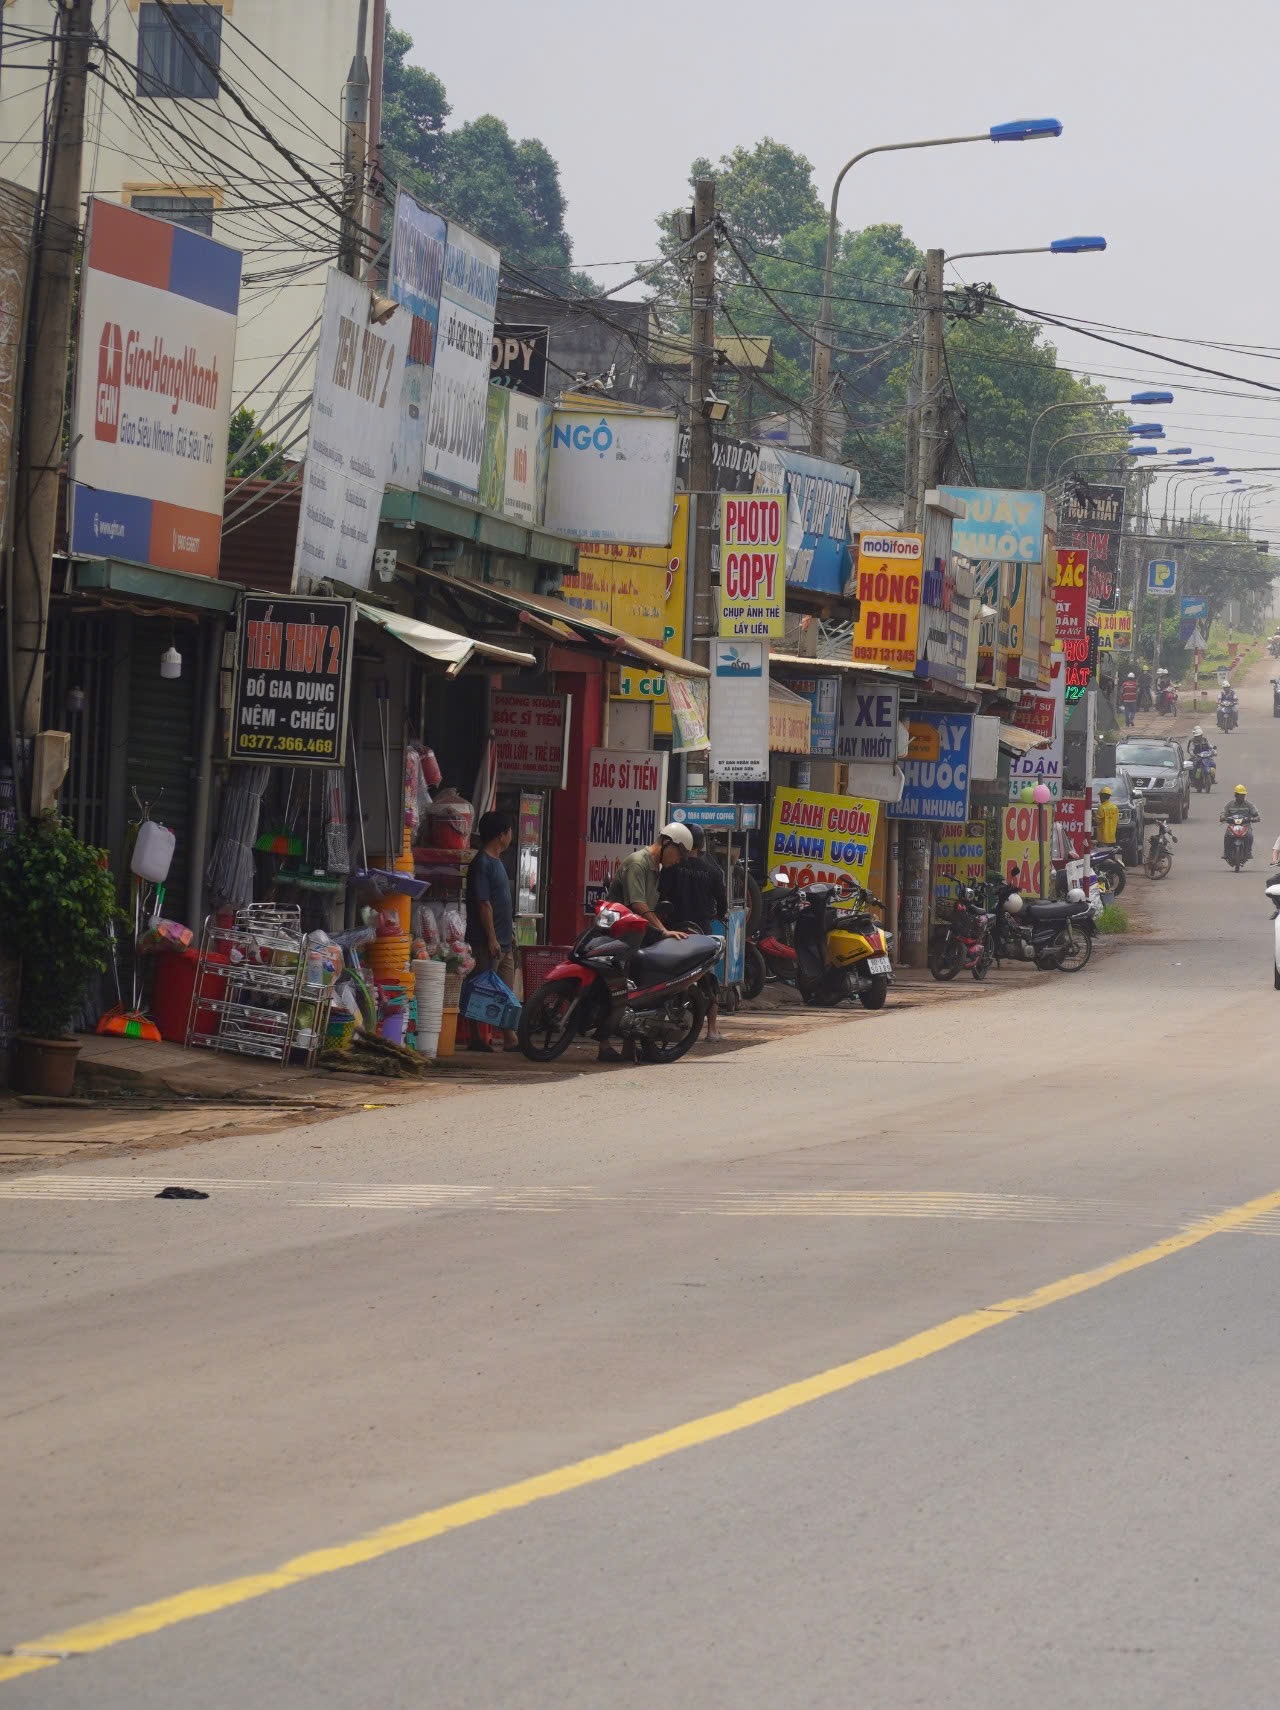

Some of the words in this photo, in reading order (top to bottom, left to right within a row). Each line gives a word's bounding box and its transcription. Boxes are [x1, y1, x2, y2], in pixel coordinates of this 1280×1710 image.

[492, 336, 537, 371] OPY
[124, 329, 219, 415] GiaoHangNhanh
[554, 417, 613, 458] NGỘ
[726, 500, 781, 545] PHOTO
[863, 539, 920, 555] mobifone
[953, 523, 1035, 559] HUỐC
[726, 552, 777, 599] COPY
[860, 563, 920, 606] HỒNG
[723, 606, 745, 620] CHỤP
[866, 611, 906, 642] PHI
[247, 604, 283, 671] TIẾN
[327, 626, 341, 674] 2
[269, 679, 292, 699] GIA
[295, 681, 334, 704] DỤNG
[241, 703, 276, 729] NỆM
[290, 706, 335, 731] CHIẾU
[855, 695, 893, 728] XE
[838, 737, 858, 757] HAY
[861, 733, 893, 758] NHỚT
[939, 716, 968, 751] ẦY
[592, 758, 615, 789] BÁC
[618, 759, 630, 790] SĨ
[633, 757, 658, 790] TIẾN
[903, 755, 969, 791] HUỐC
[1022, 756, 1059, 774] DÂN
[590, 799, 623, 845] KHÁM
[716, 811, 735, 821] COFFEE
[780, 798, 826, 830] BÁNH
[827, 803, 872, 837] CUỐN
[922, 798, 964, 818] NHUNG
[773, 830, 826, 861] BÁNH
